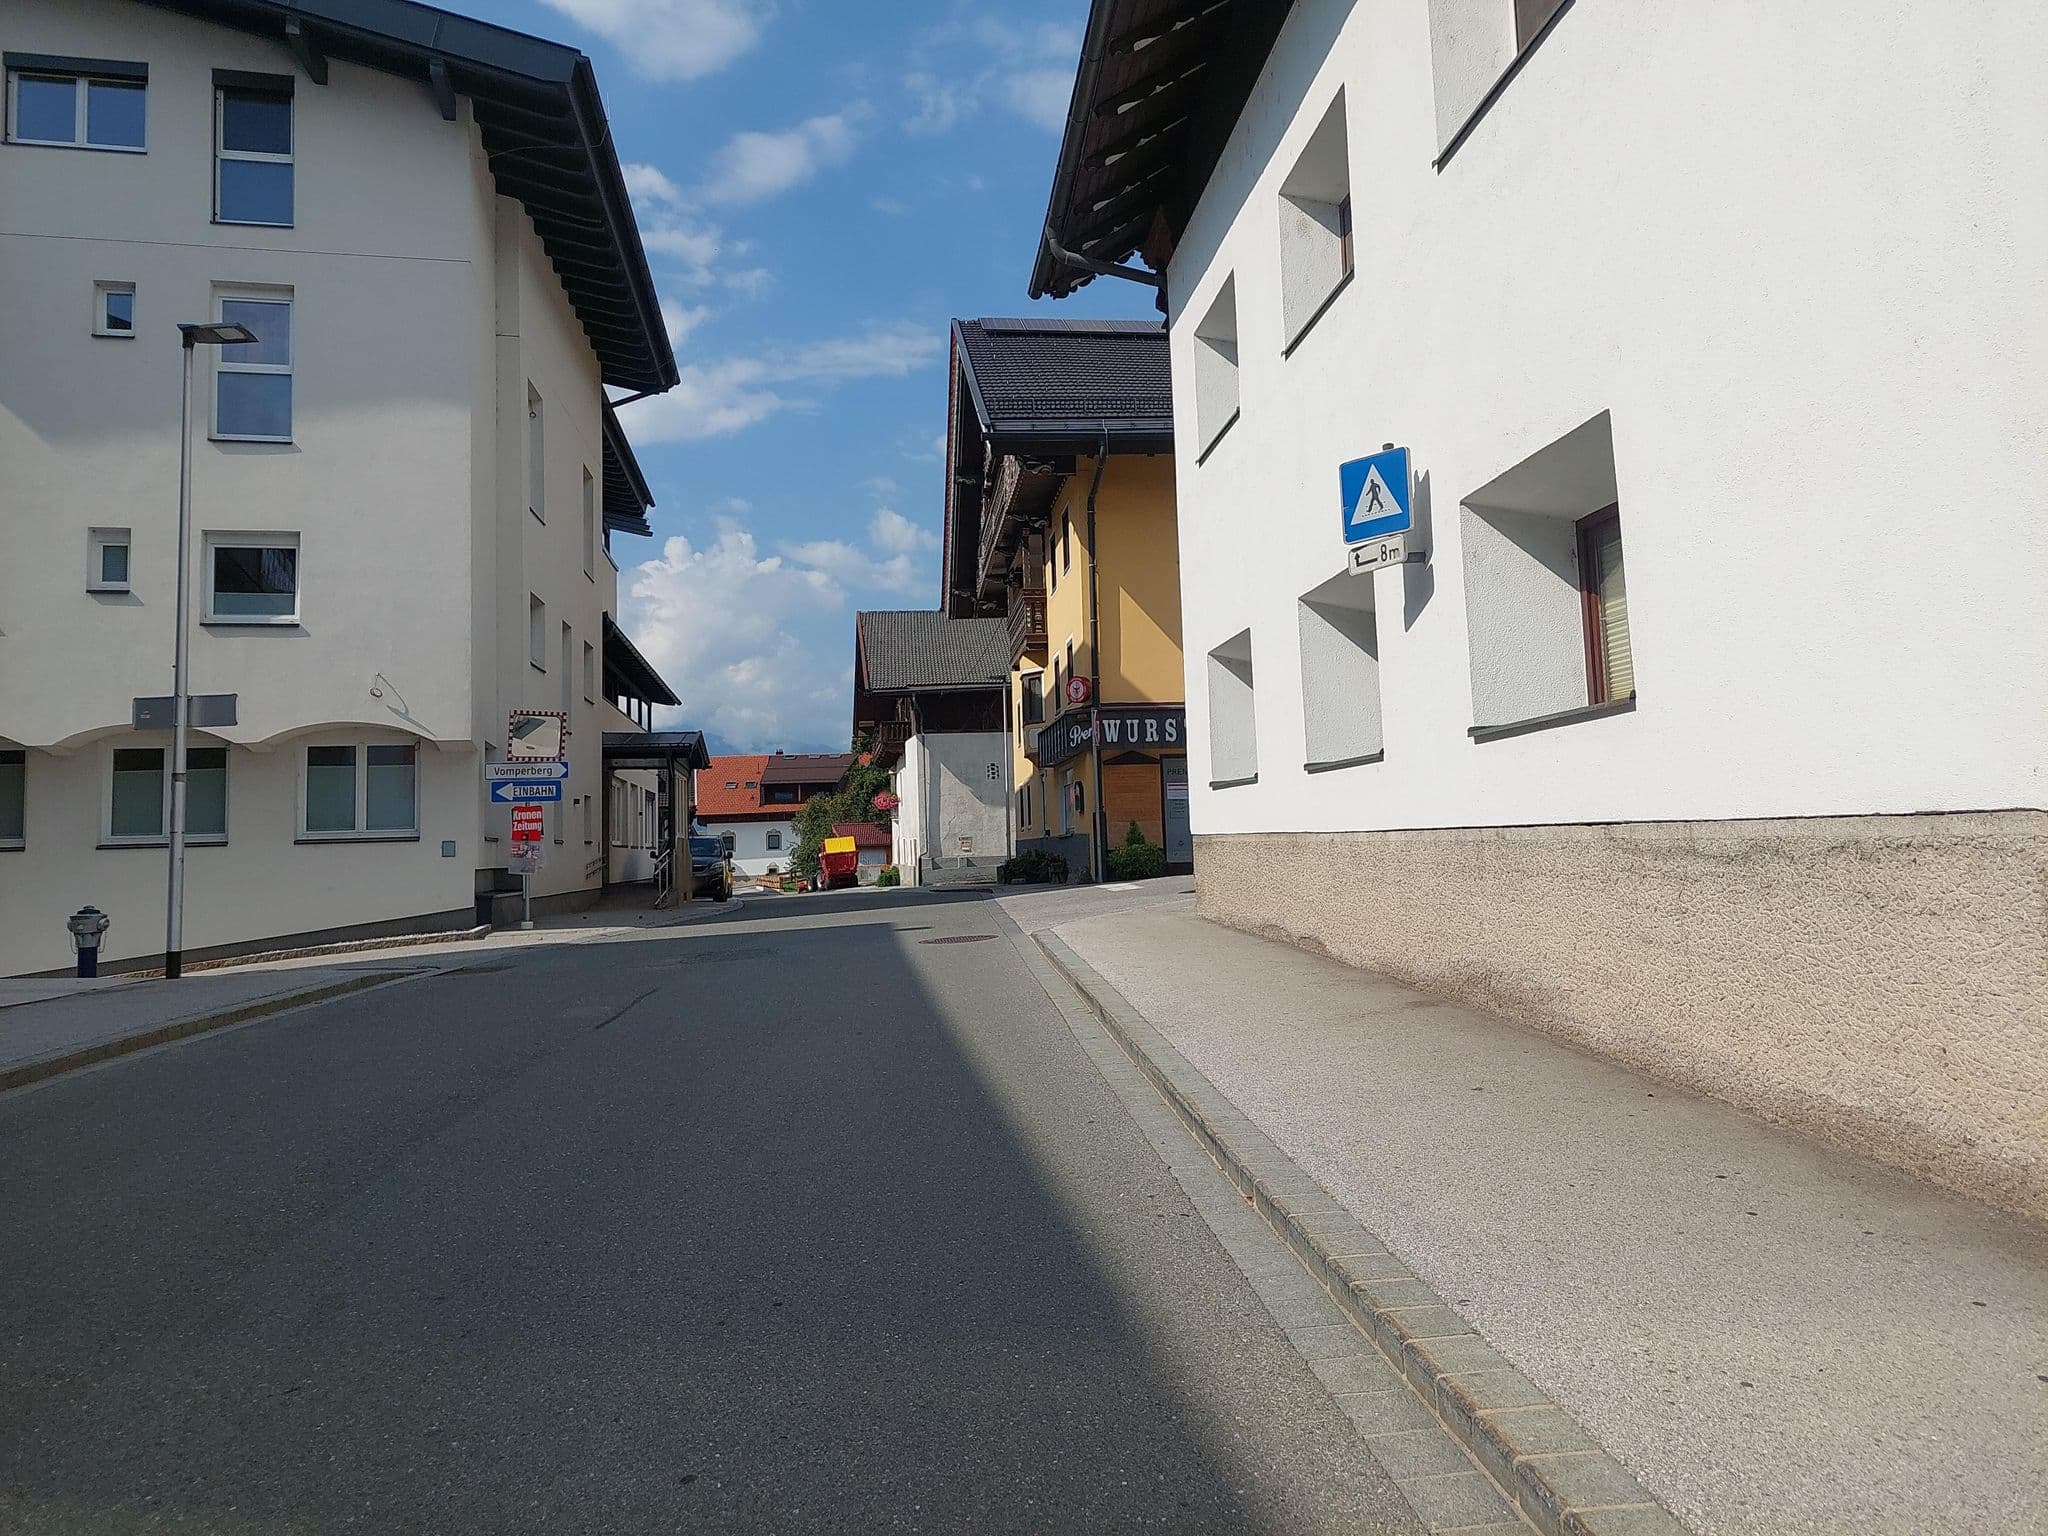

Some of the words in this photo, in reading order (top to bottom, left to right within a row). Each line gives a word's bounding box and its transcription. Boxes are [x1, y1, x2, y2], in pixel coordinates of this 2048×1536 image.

[1380, 543, 1400, 562] 8m
[1102, 718, 1187, 743] WURS
[494, 766, 553, 777] Vomperberg
[513, 786, 554, 797] EINBAHN
[513, 811, 542, 820] Kronen
[513, 821, 542, 831] Zeitung
